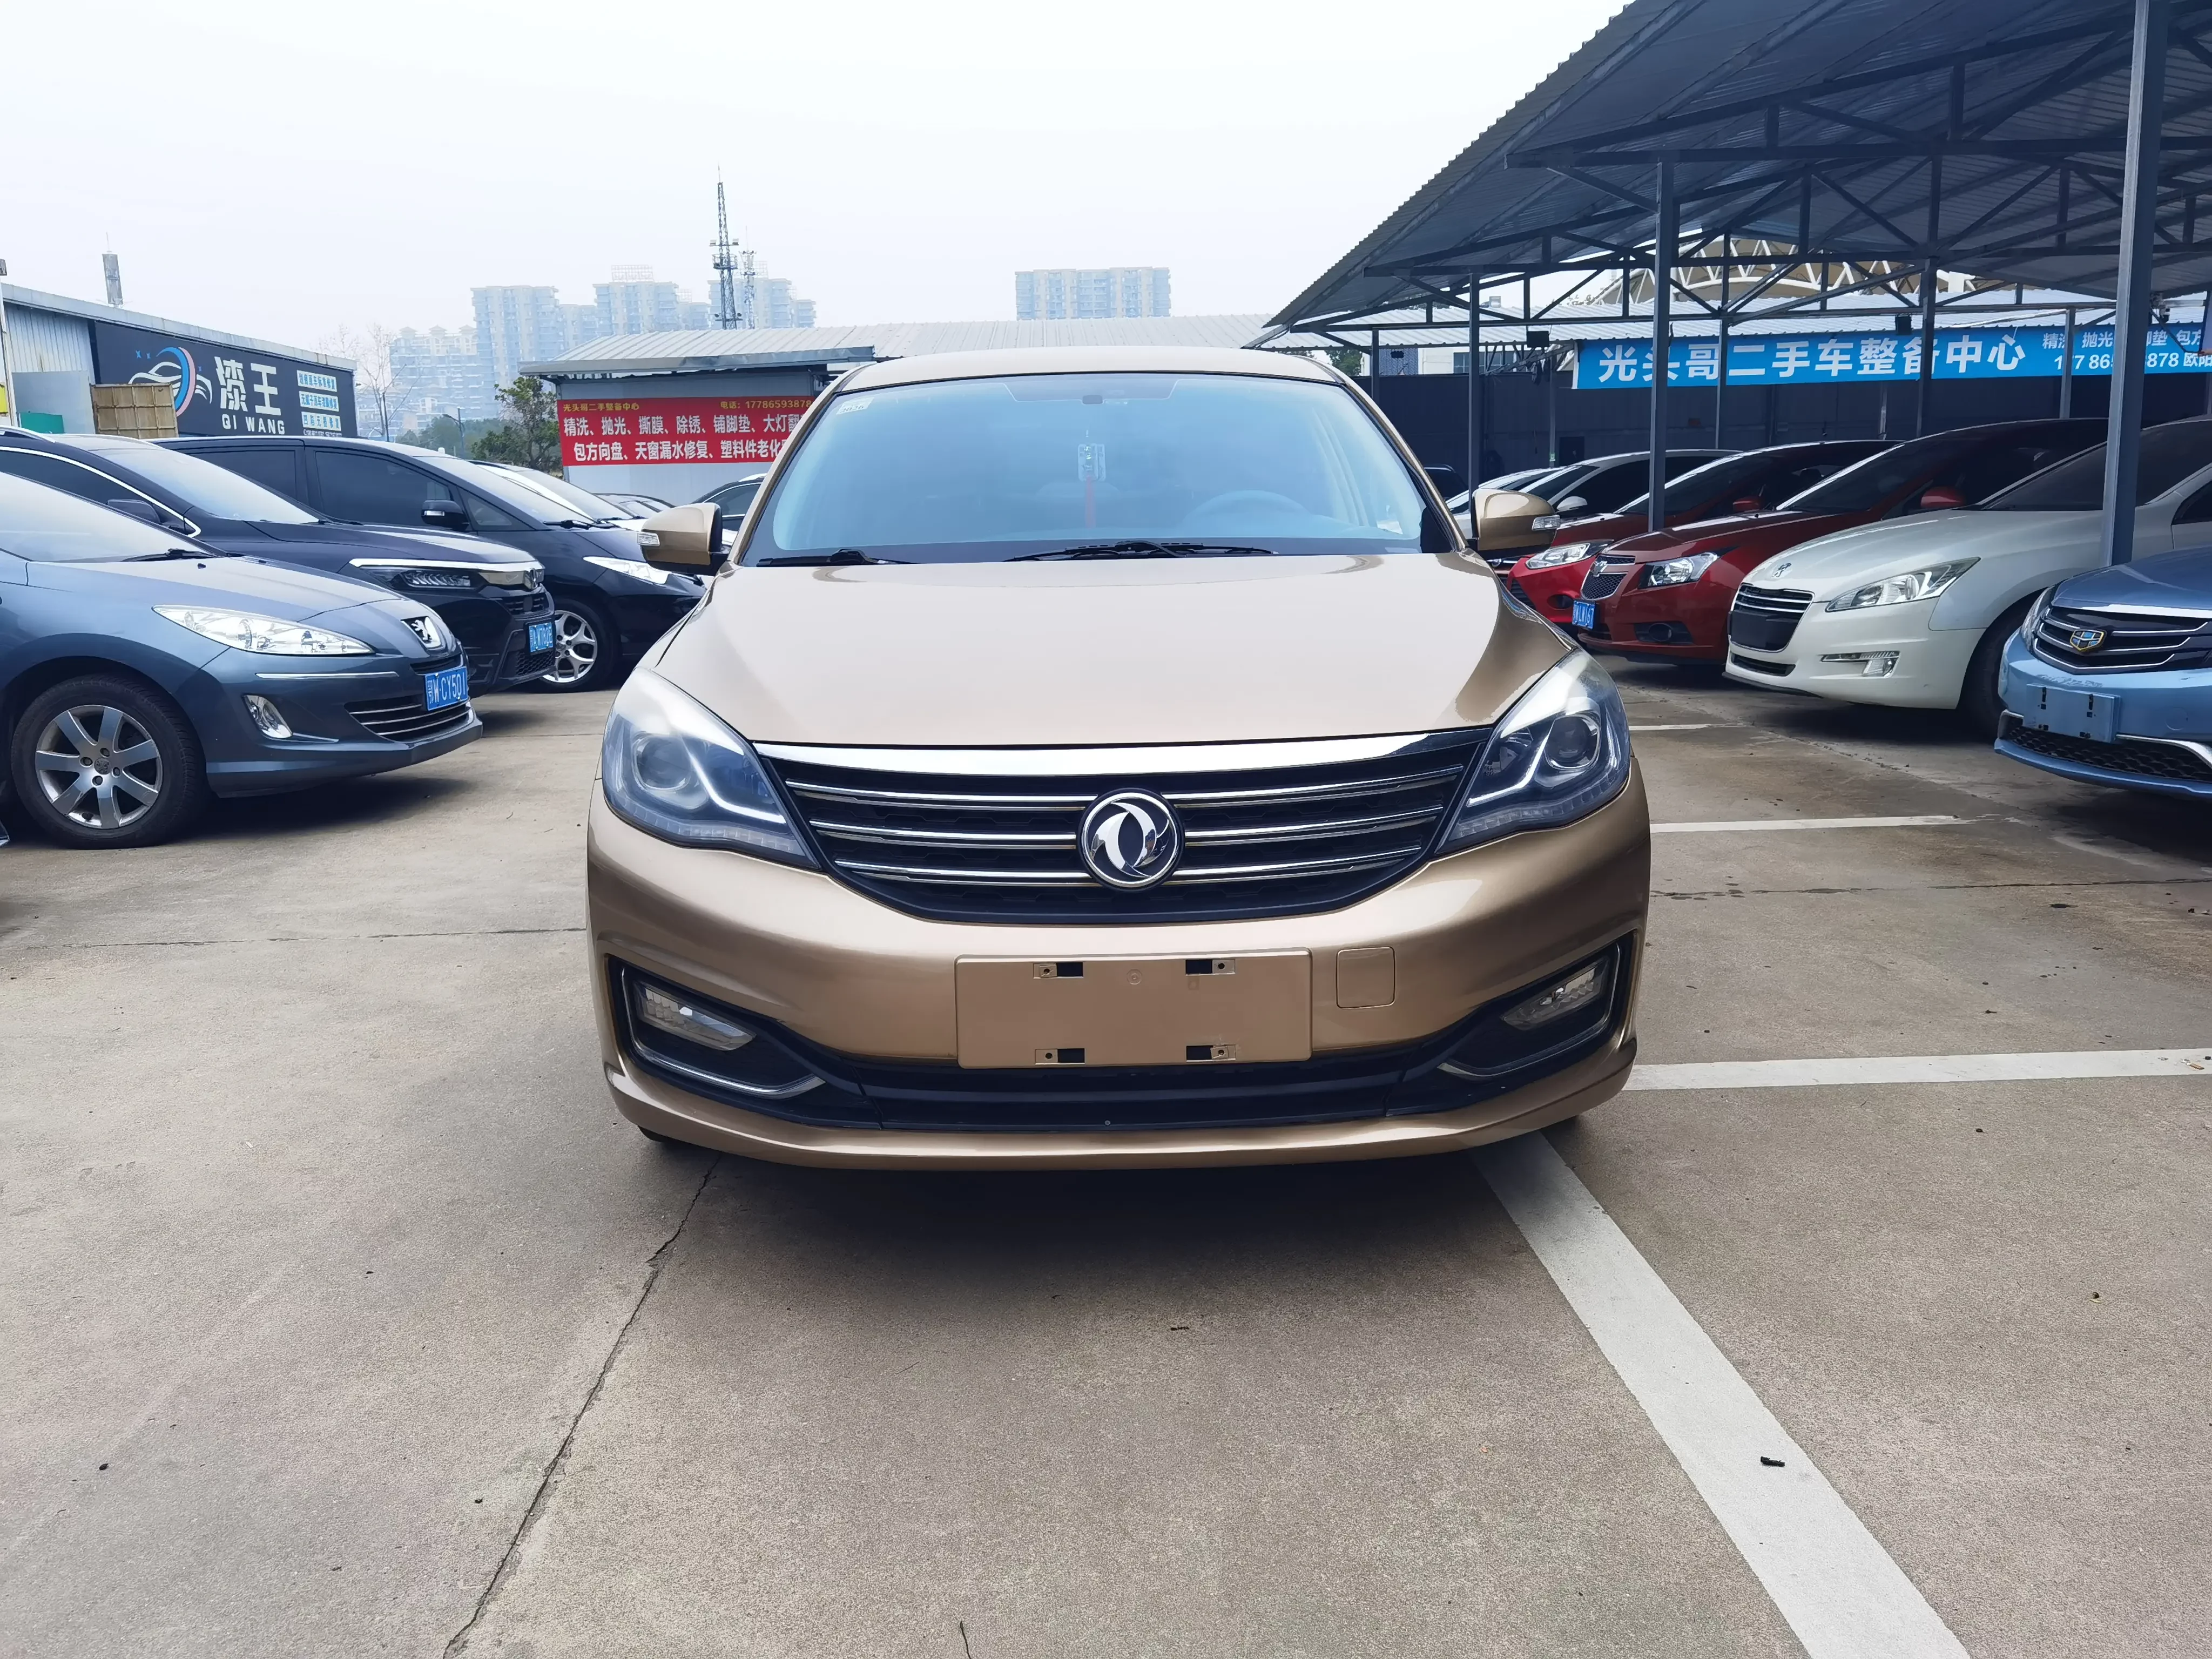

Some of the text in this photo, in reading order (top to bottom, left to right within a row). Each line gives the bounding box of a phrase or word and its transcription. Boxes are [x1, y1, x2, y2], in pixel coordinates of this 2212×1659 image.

[2081, 331, 2114, 348] 抛光
[214, 356, 281, 416] 漆王
[563, 402, 639, 412] 光头哥二手整备中心
[222, 414, 237, 430] QI
[245, 416, 285, 435] WANG
